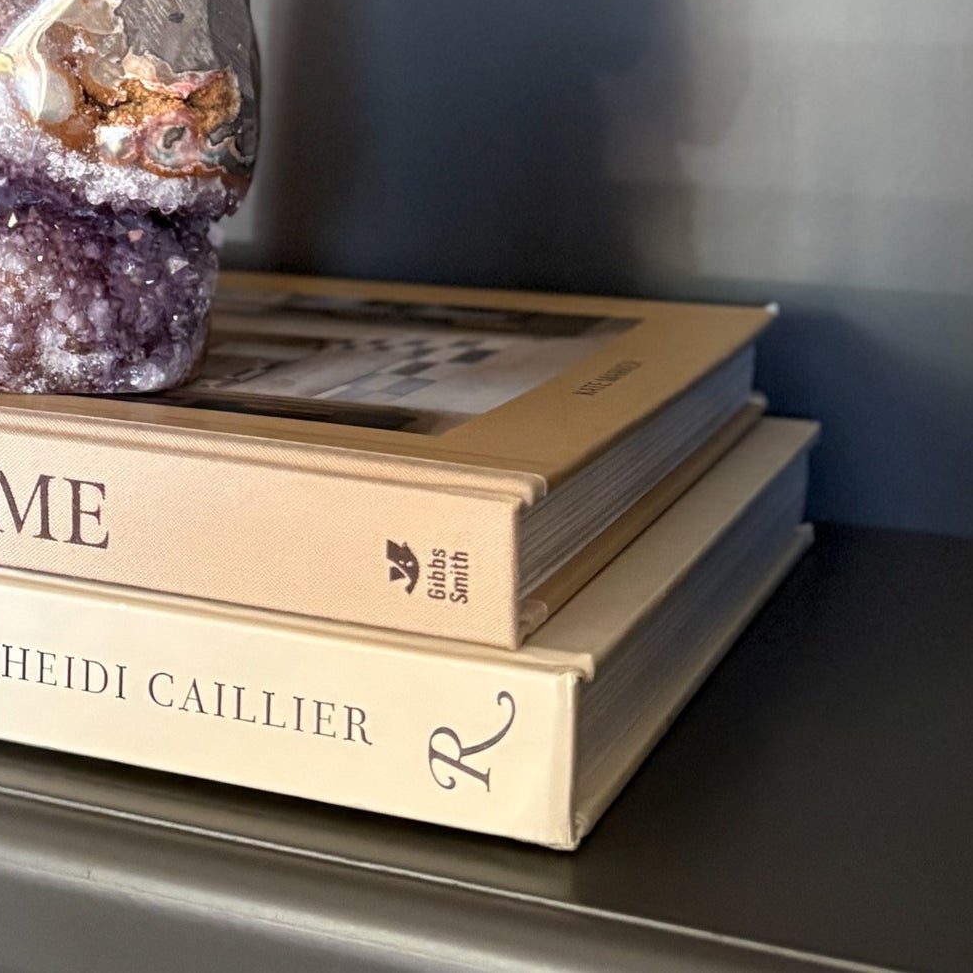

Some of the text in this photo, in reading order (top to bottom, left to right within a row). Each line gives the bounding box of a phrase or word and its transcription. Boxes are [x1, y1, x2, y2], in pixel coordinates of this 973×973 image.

[427, 548, 447, 600] Gibbs
[449, 551, 469, 604] Smith
[1, 644, 128, 700] HEIDI
[147, 672, 373, 745] CAILLIER
